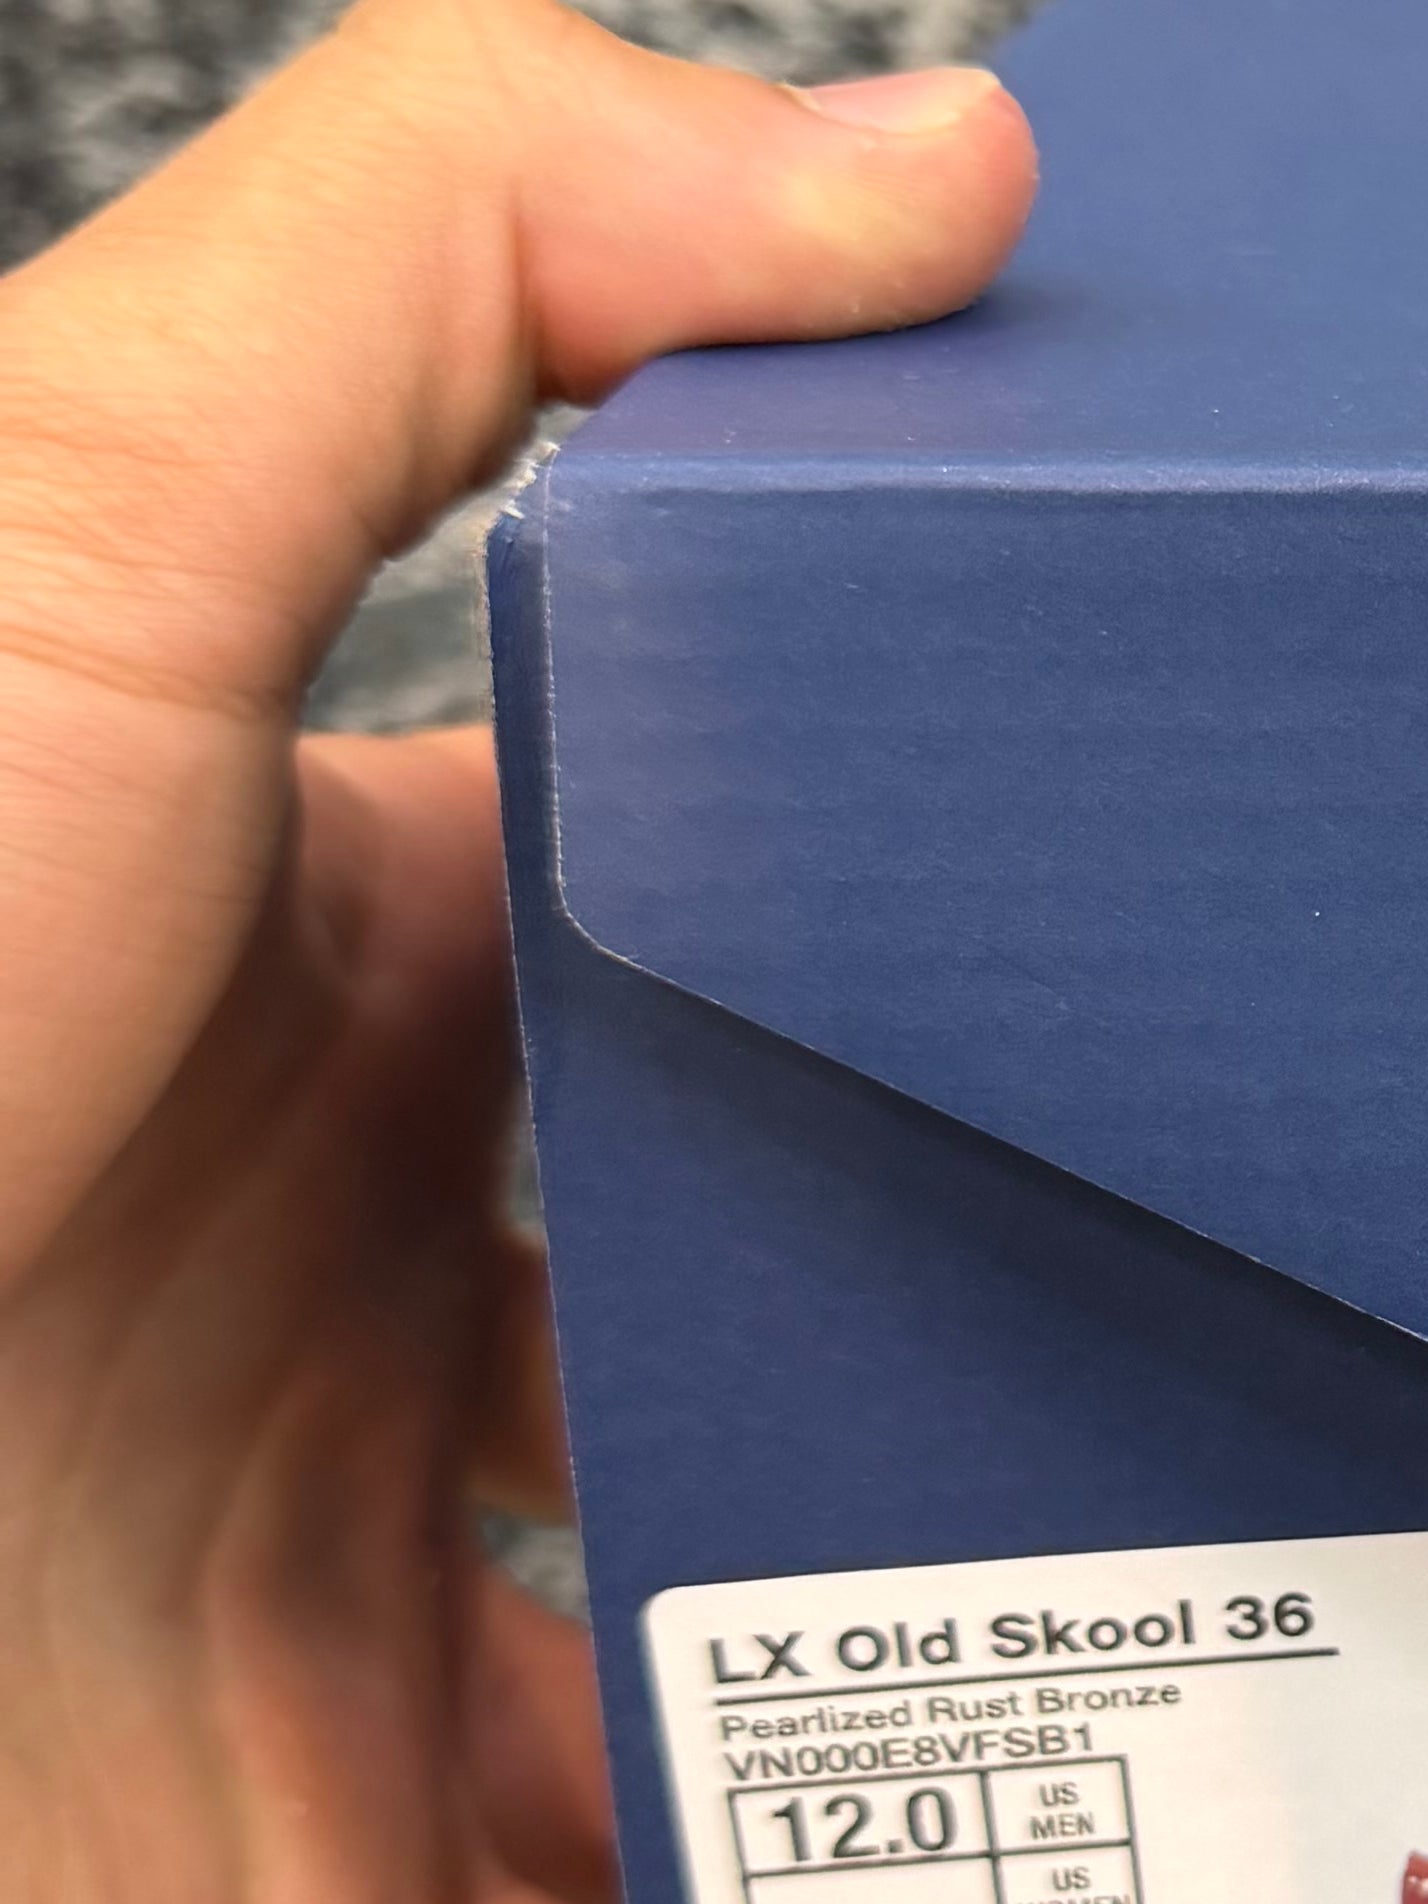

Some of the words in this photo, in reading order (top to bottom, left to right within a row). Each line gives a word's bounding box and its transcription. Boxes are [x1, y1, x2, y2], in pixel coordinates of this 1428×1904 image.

[709, 1631, 809, 1684] LX
[837, 1619, 960, 1673] Old
[991, 1599, 1196, 1660] Skool
[1225, 1593, 1314, 1640] 36
[720, 1700, 914, 1741] Pearlized
[927, 1695, 1024, 1724] Rust
[1036, 1683, 1182, 1714] Bronze
[724, 1723, 1094, 1781] VN000E8VFSB1
[1040, 1782, 1079, 1806] US
[772, 1787, 957, 1863] 12.0
[1030, 1811, 1096, 1841] MEN
[1052, 1867, 1091, 1891] US
